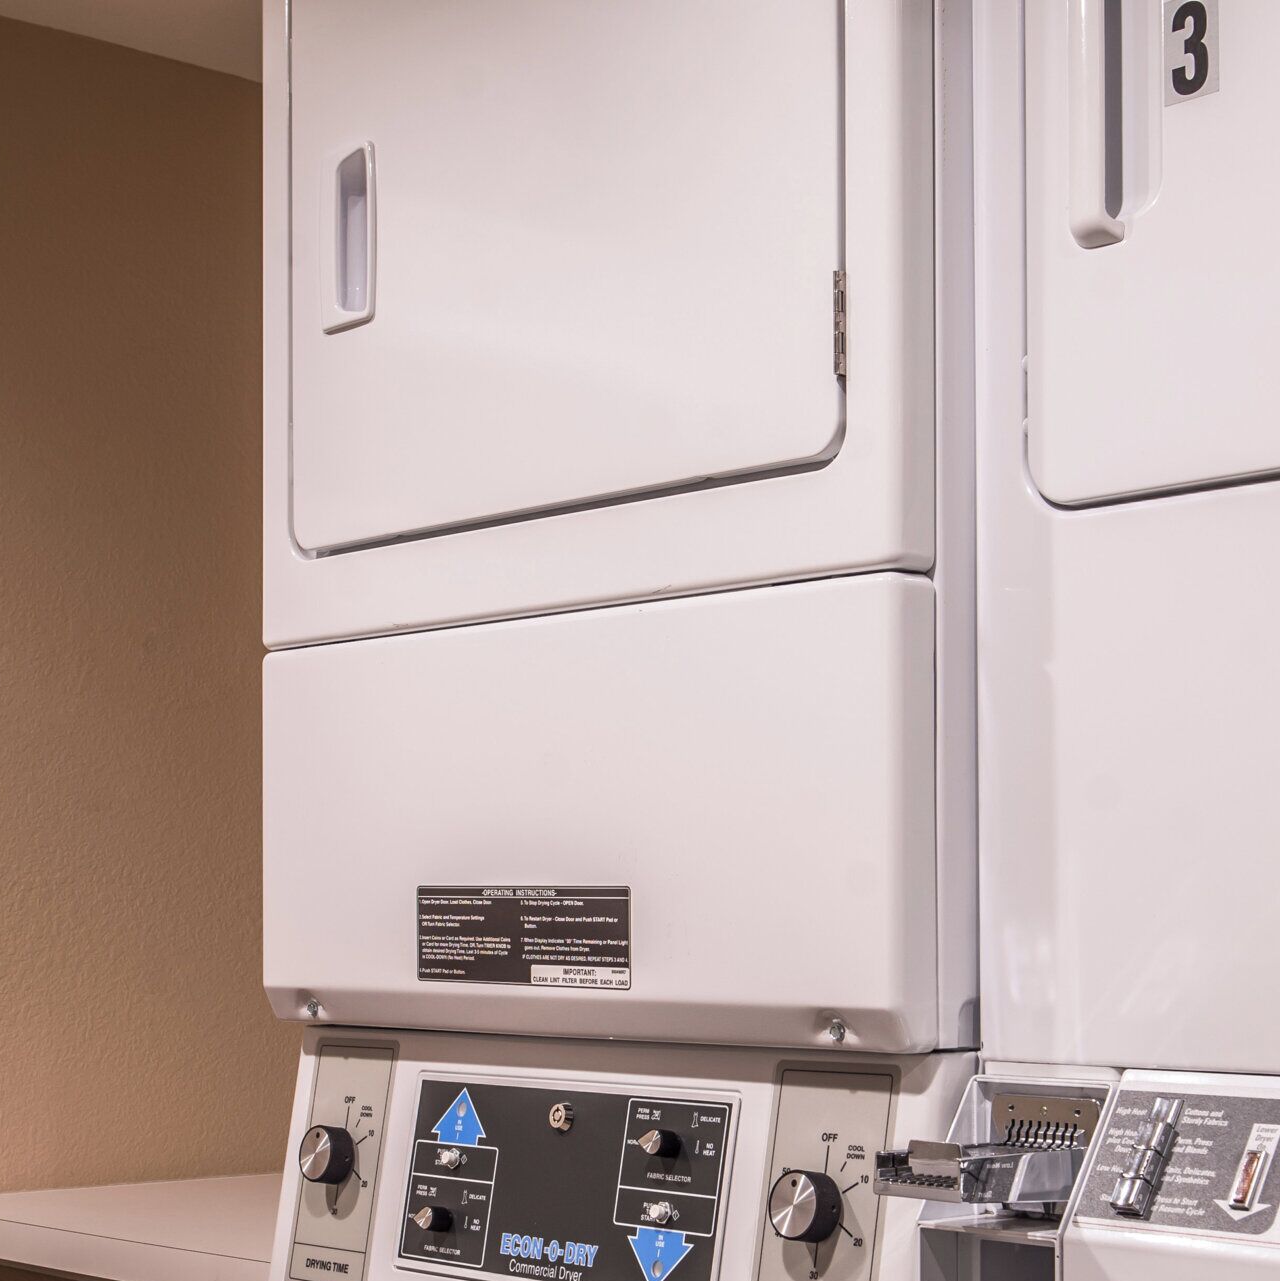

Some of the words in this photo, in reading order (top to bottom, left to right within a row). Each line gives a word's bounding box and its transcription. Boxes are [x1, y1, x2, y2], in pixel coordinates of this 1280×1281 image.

[1172, 1, 1208, 95] 3
[563, 969, 597, 977] IMPORTANT:
[344, 1096, 356, 1104] OFF
[700, 1115, 721, 1124] DELICATE
[1256, 1125, 1279, 1134] Lower
[821, 1132, 838, 1142] OFF
[1255, 1134, 1274, 1143] Dryer
[703, 1149, 716, 1157] HEAT
[846, 1153, 865, 1161] DOWN
[646, 1172, 665, 1181] FABRIC
[666, 1174, 692, 1183] SELECTOR
[860, 1174, 869, 1184] 10
[361, 1180, 368, 1188] 20
[853, 1237, 862, 1247] 20
[424, 1244, 438, 1253] FABRIC
[439, 1246, 461, 1256] SELECTOR
[305, 1258, 331, 1272] DRYING
[332, 1263, 350, 1274] TIME
[509, 1258, 558, 1278] Commercial
[809, 1270, 818, 1280] 30
